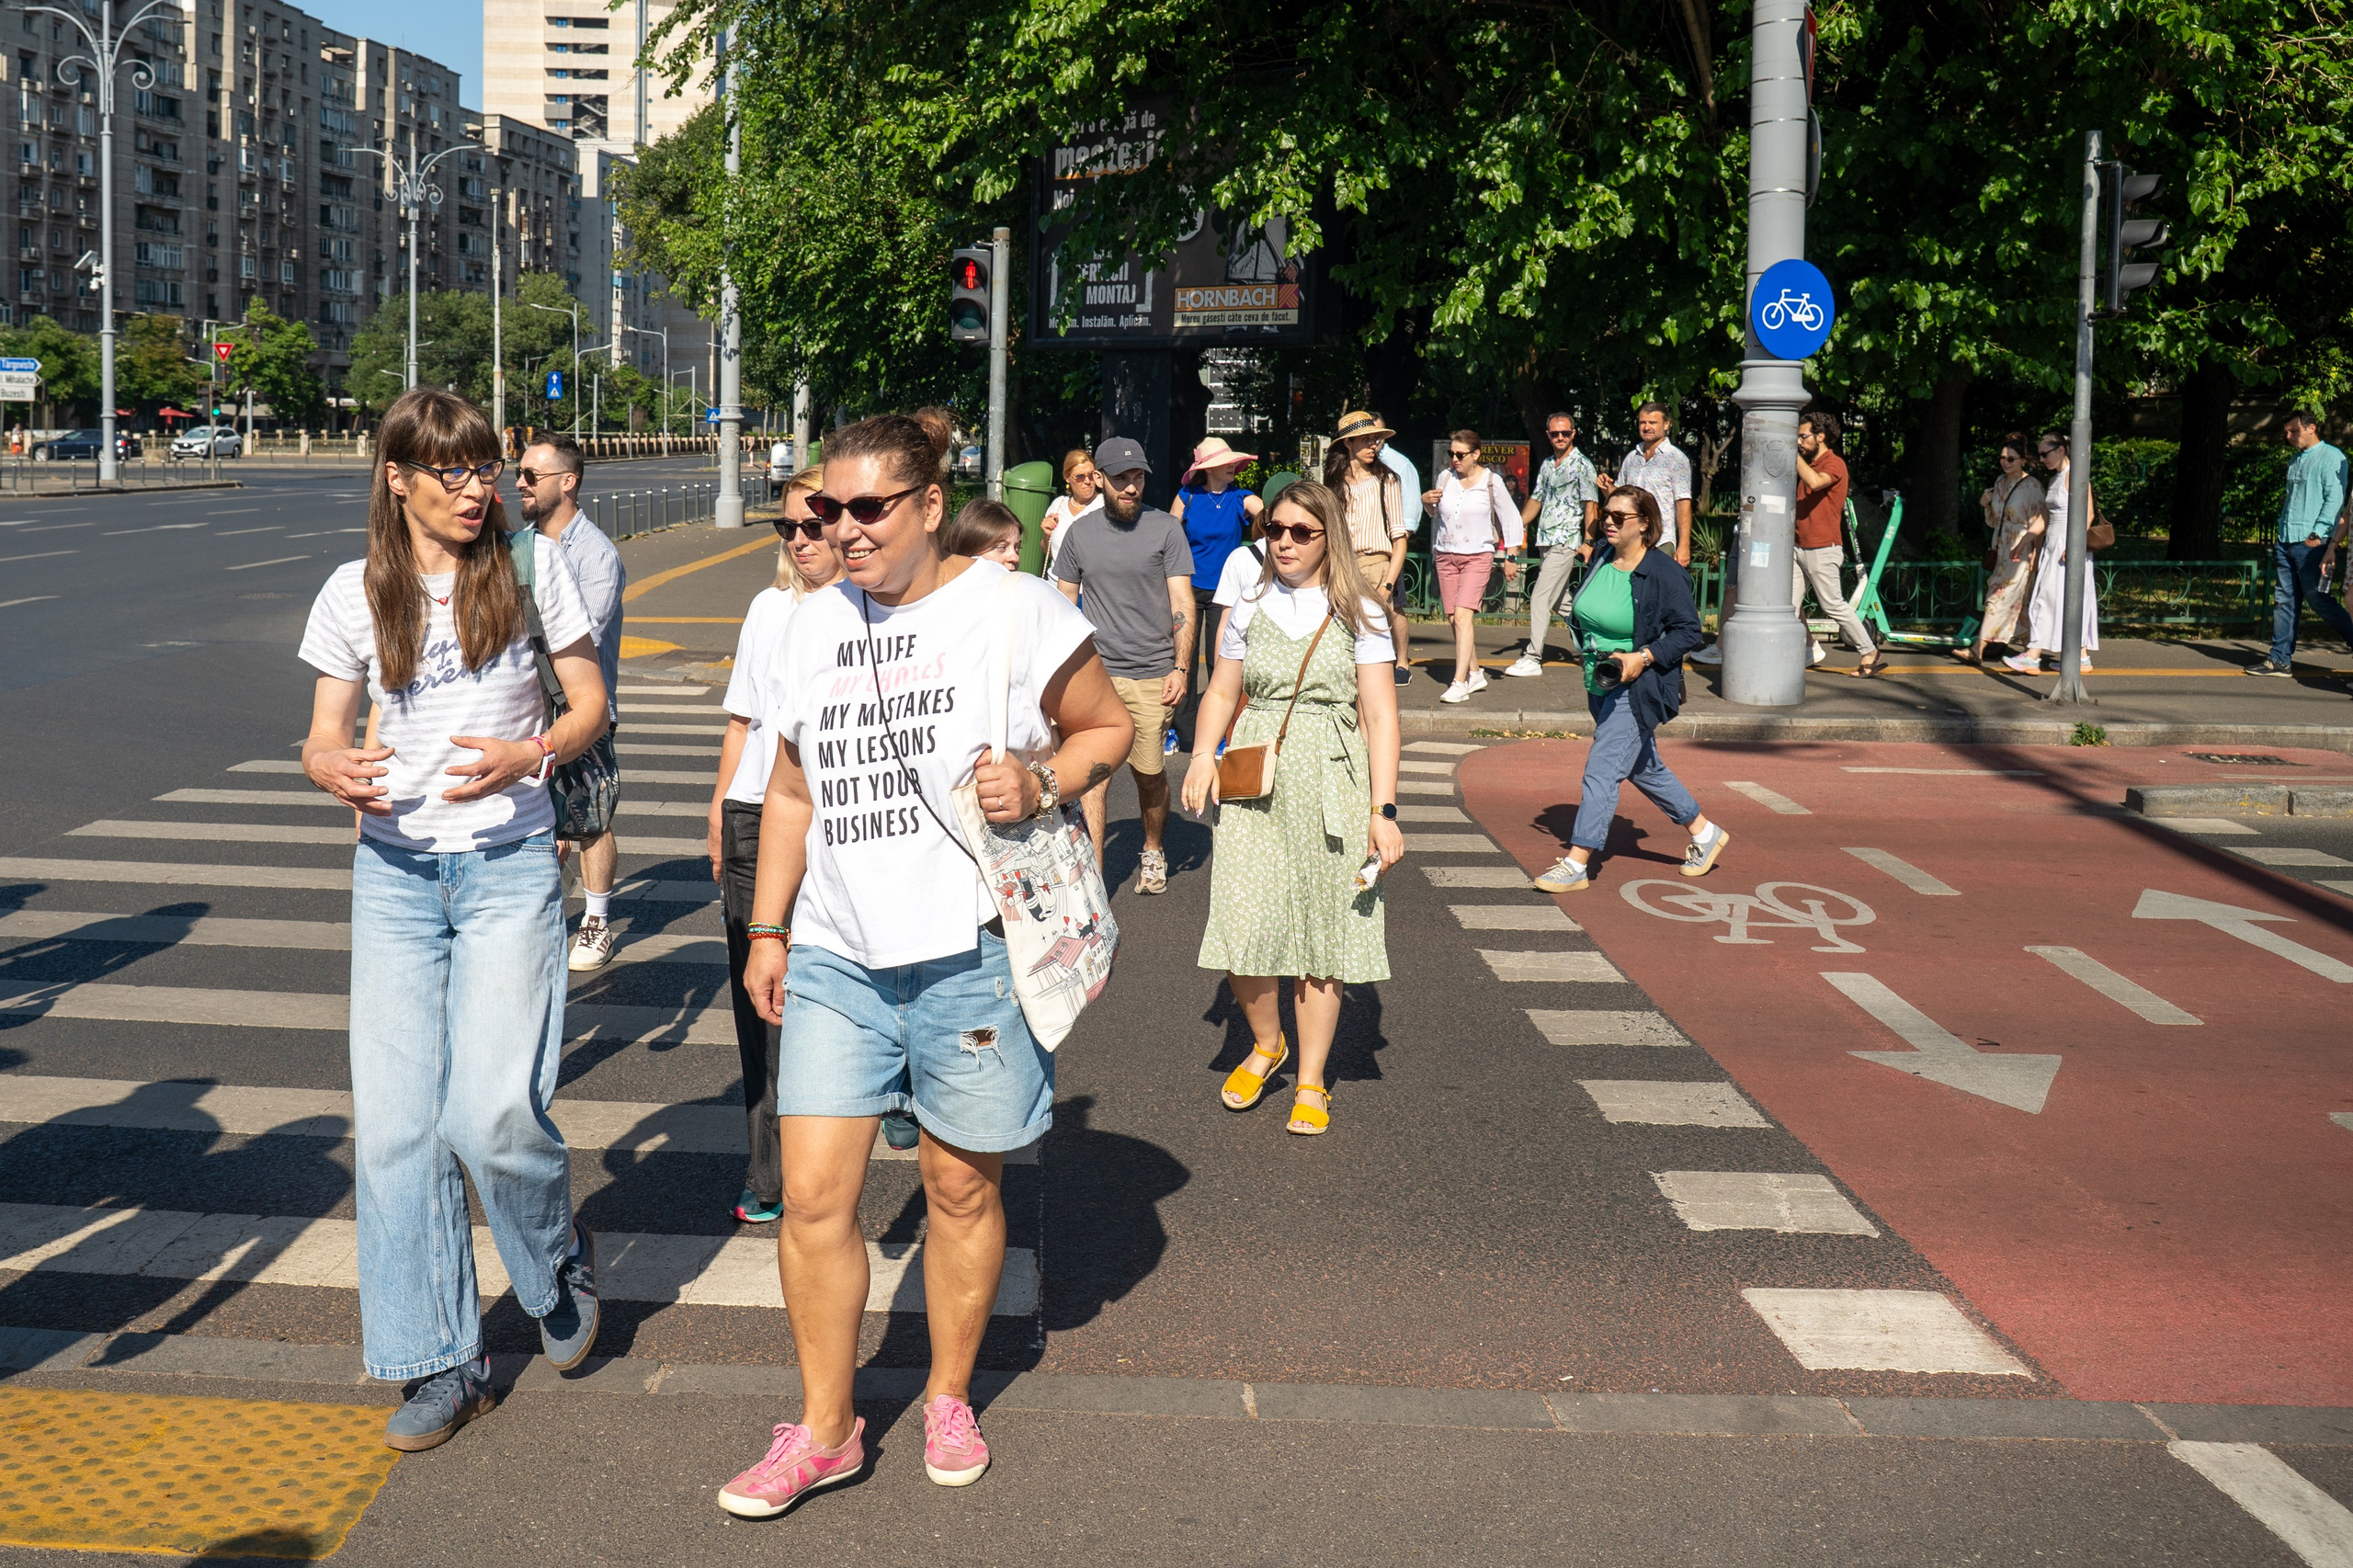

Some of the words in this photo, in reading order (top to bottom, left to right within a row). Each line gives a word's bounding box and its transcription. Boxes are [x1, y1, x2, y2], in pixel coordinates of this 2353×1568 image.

[1141, 109, 1156, 129] de
[1086, 284, 1137, 305] MONTAJ
[1176, 287, 1276, 309] HORNBACH
[1181, 313, 1200, 324] Mereu
[1244, 313, 1259, 322] ceva
[1261, 312, 1269, 322] de
[1481, 446, 1515, 455] REVER
[1885, 525, 1895, 540] Bolt
[837, 639, 868, 667] MY
[876, 634, 916, 665] LIFE
[829, 674, 864, 698] MY
[819, 703, 851, 732] MY
[858, 687, 955, 727] MISTAKES
[818, 739, 847, 769] MY
[857, 725, 936, 765] LESSONS
[822, 777, 860, 808] NOT
[868, 767, 923, 801] YOUR
[824, 806, 919, 846] BUSINESS
